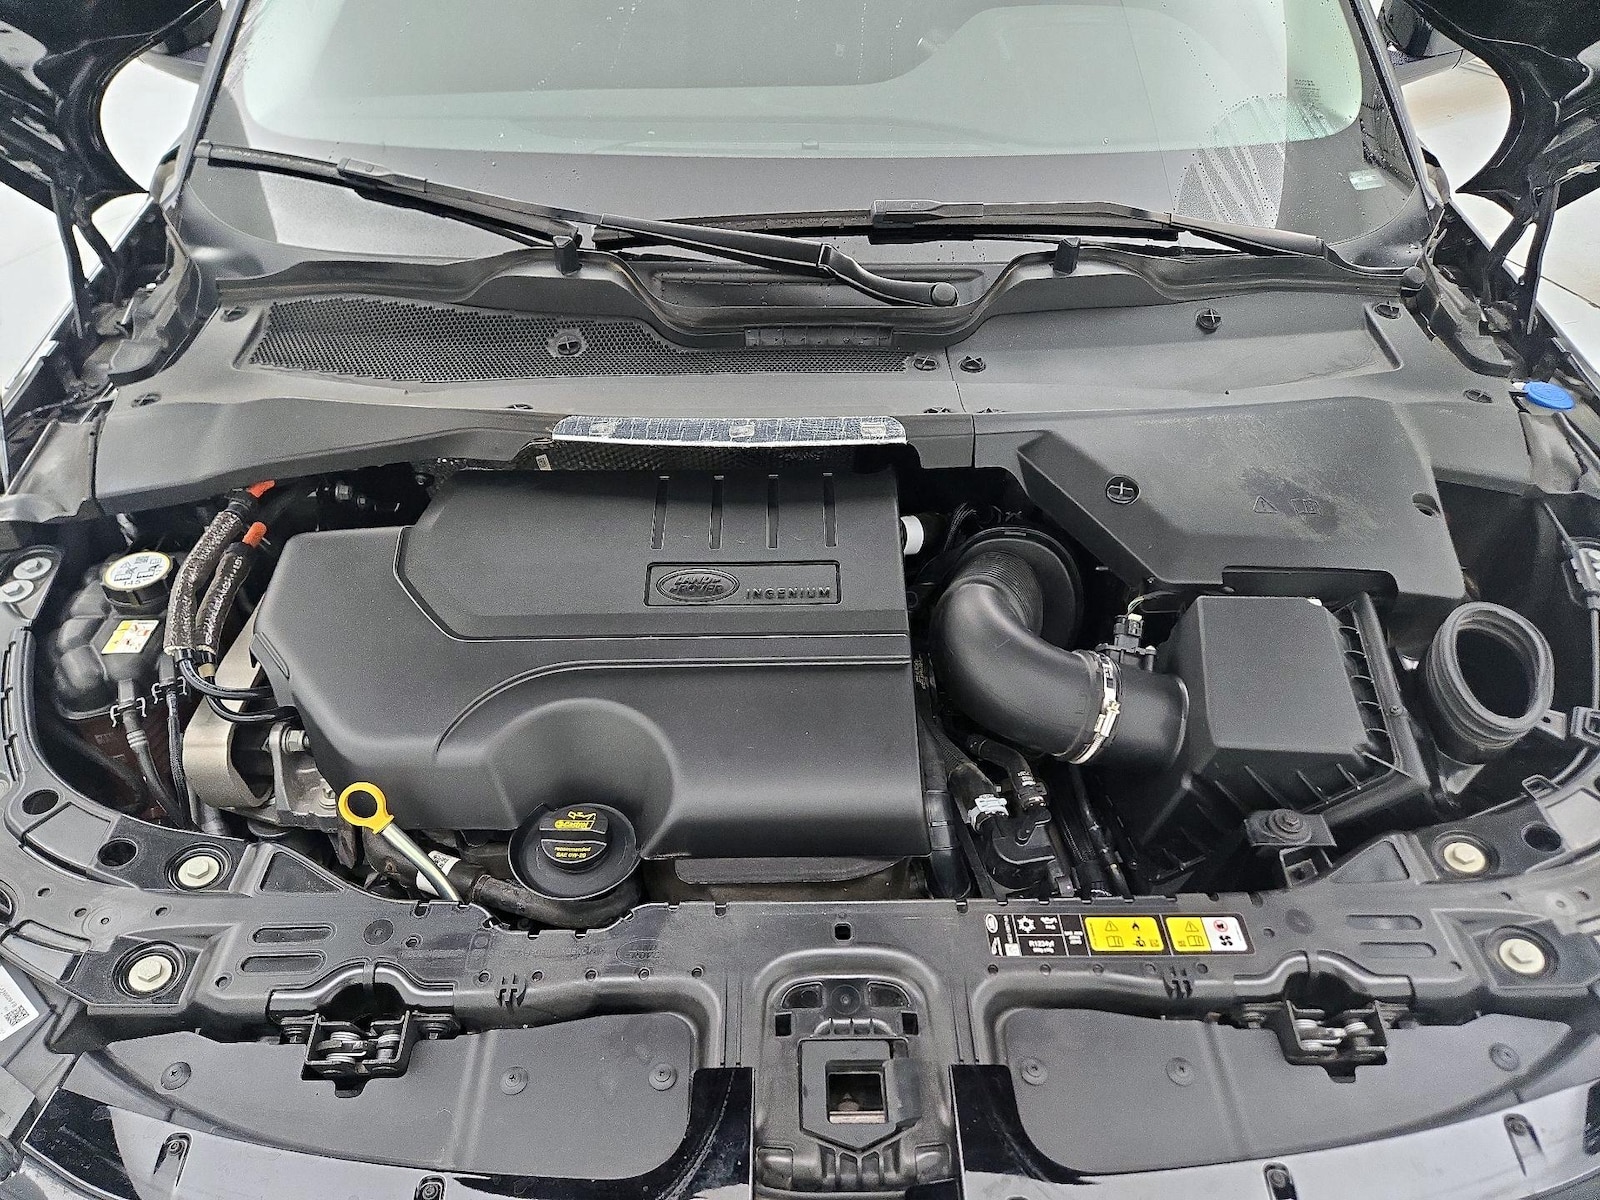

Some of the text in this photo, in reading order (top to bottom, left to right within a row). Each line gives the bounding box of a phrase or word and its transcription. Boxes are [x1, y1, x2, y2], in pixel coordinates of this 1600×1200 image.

[674, 576, 721, 585] LAND
[669, 583, 725, 595] ROVER
[745, 587, 830, 600] INGENIUM
